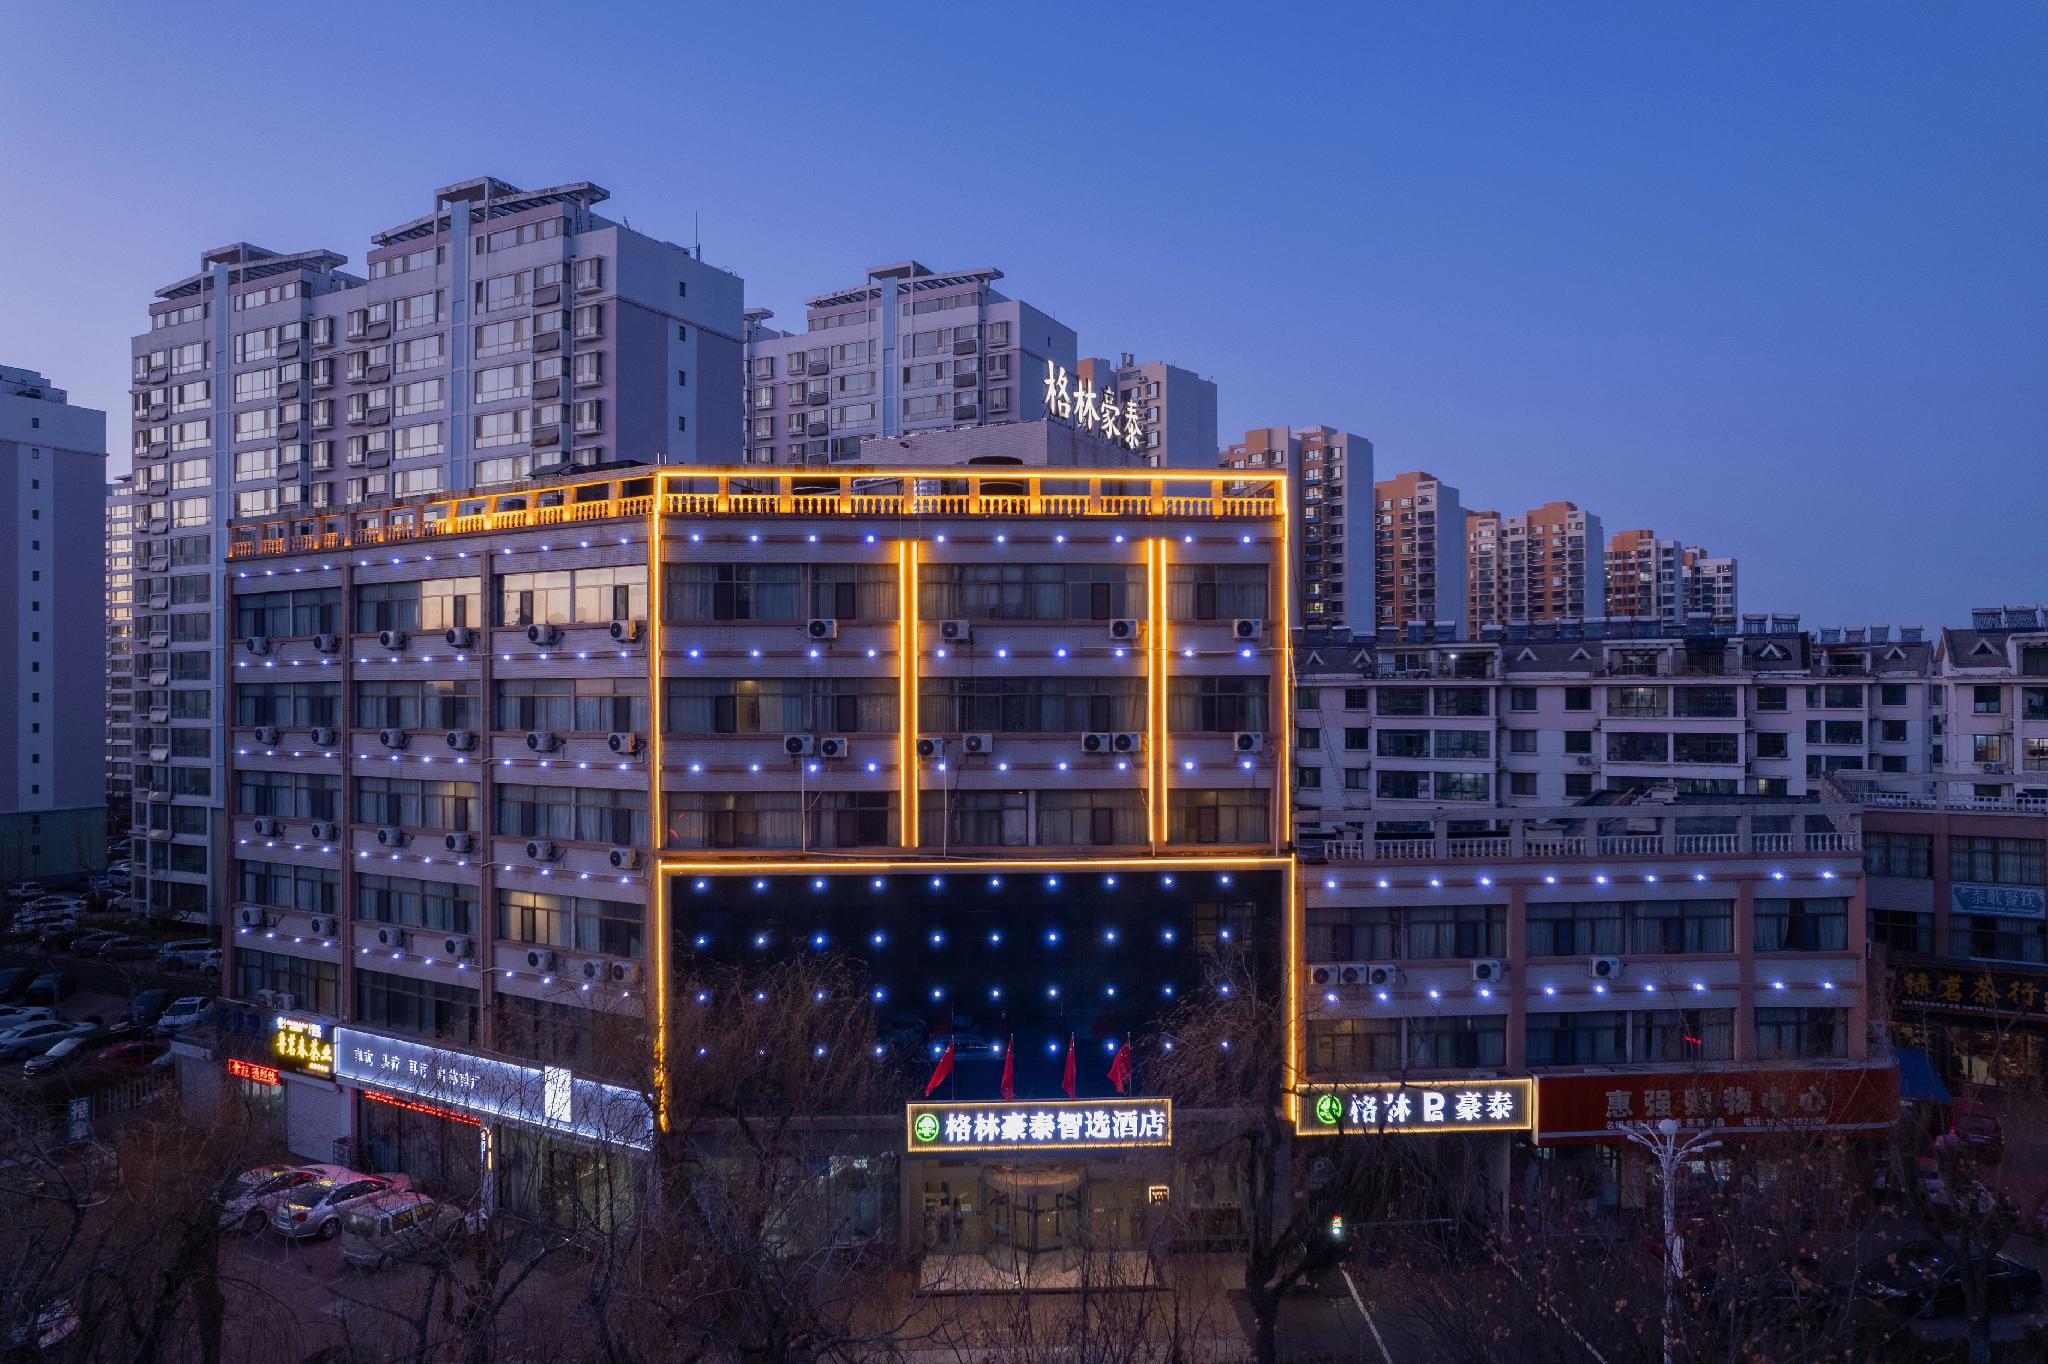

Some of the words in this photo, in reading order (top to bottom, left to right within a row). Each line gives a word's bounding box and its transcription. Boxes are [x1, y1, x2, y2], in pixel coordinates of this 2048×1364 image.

[1043, 360, 1143, 450] 格林豪泰
[945, 1109, 1166, 1142] 格林豪泰智选酒店
